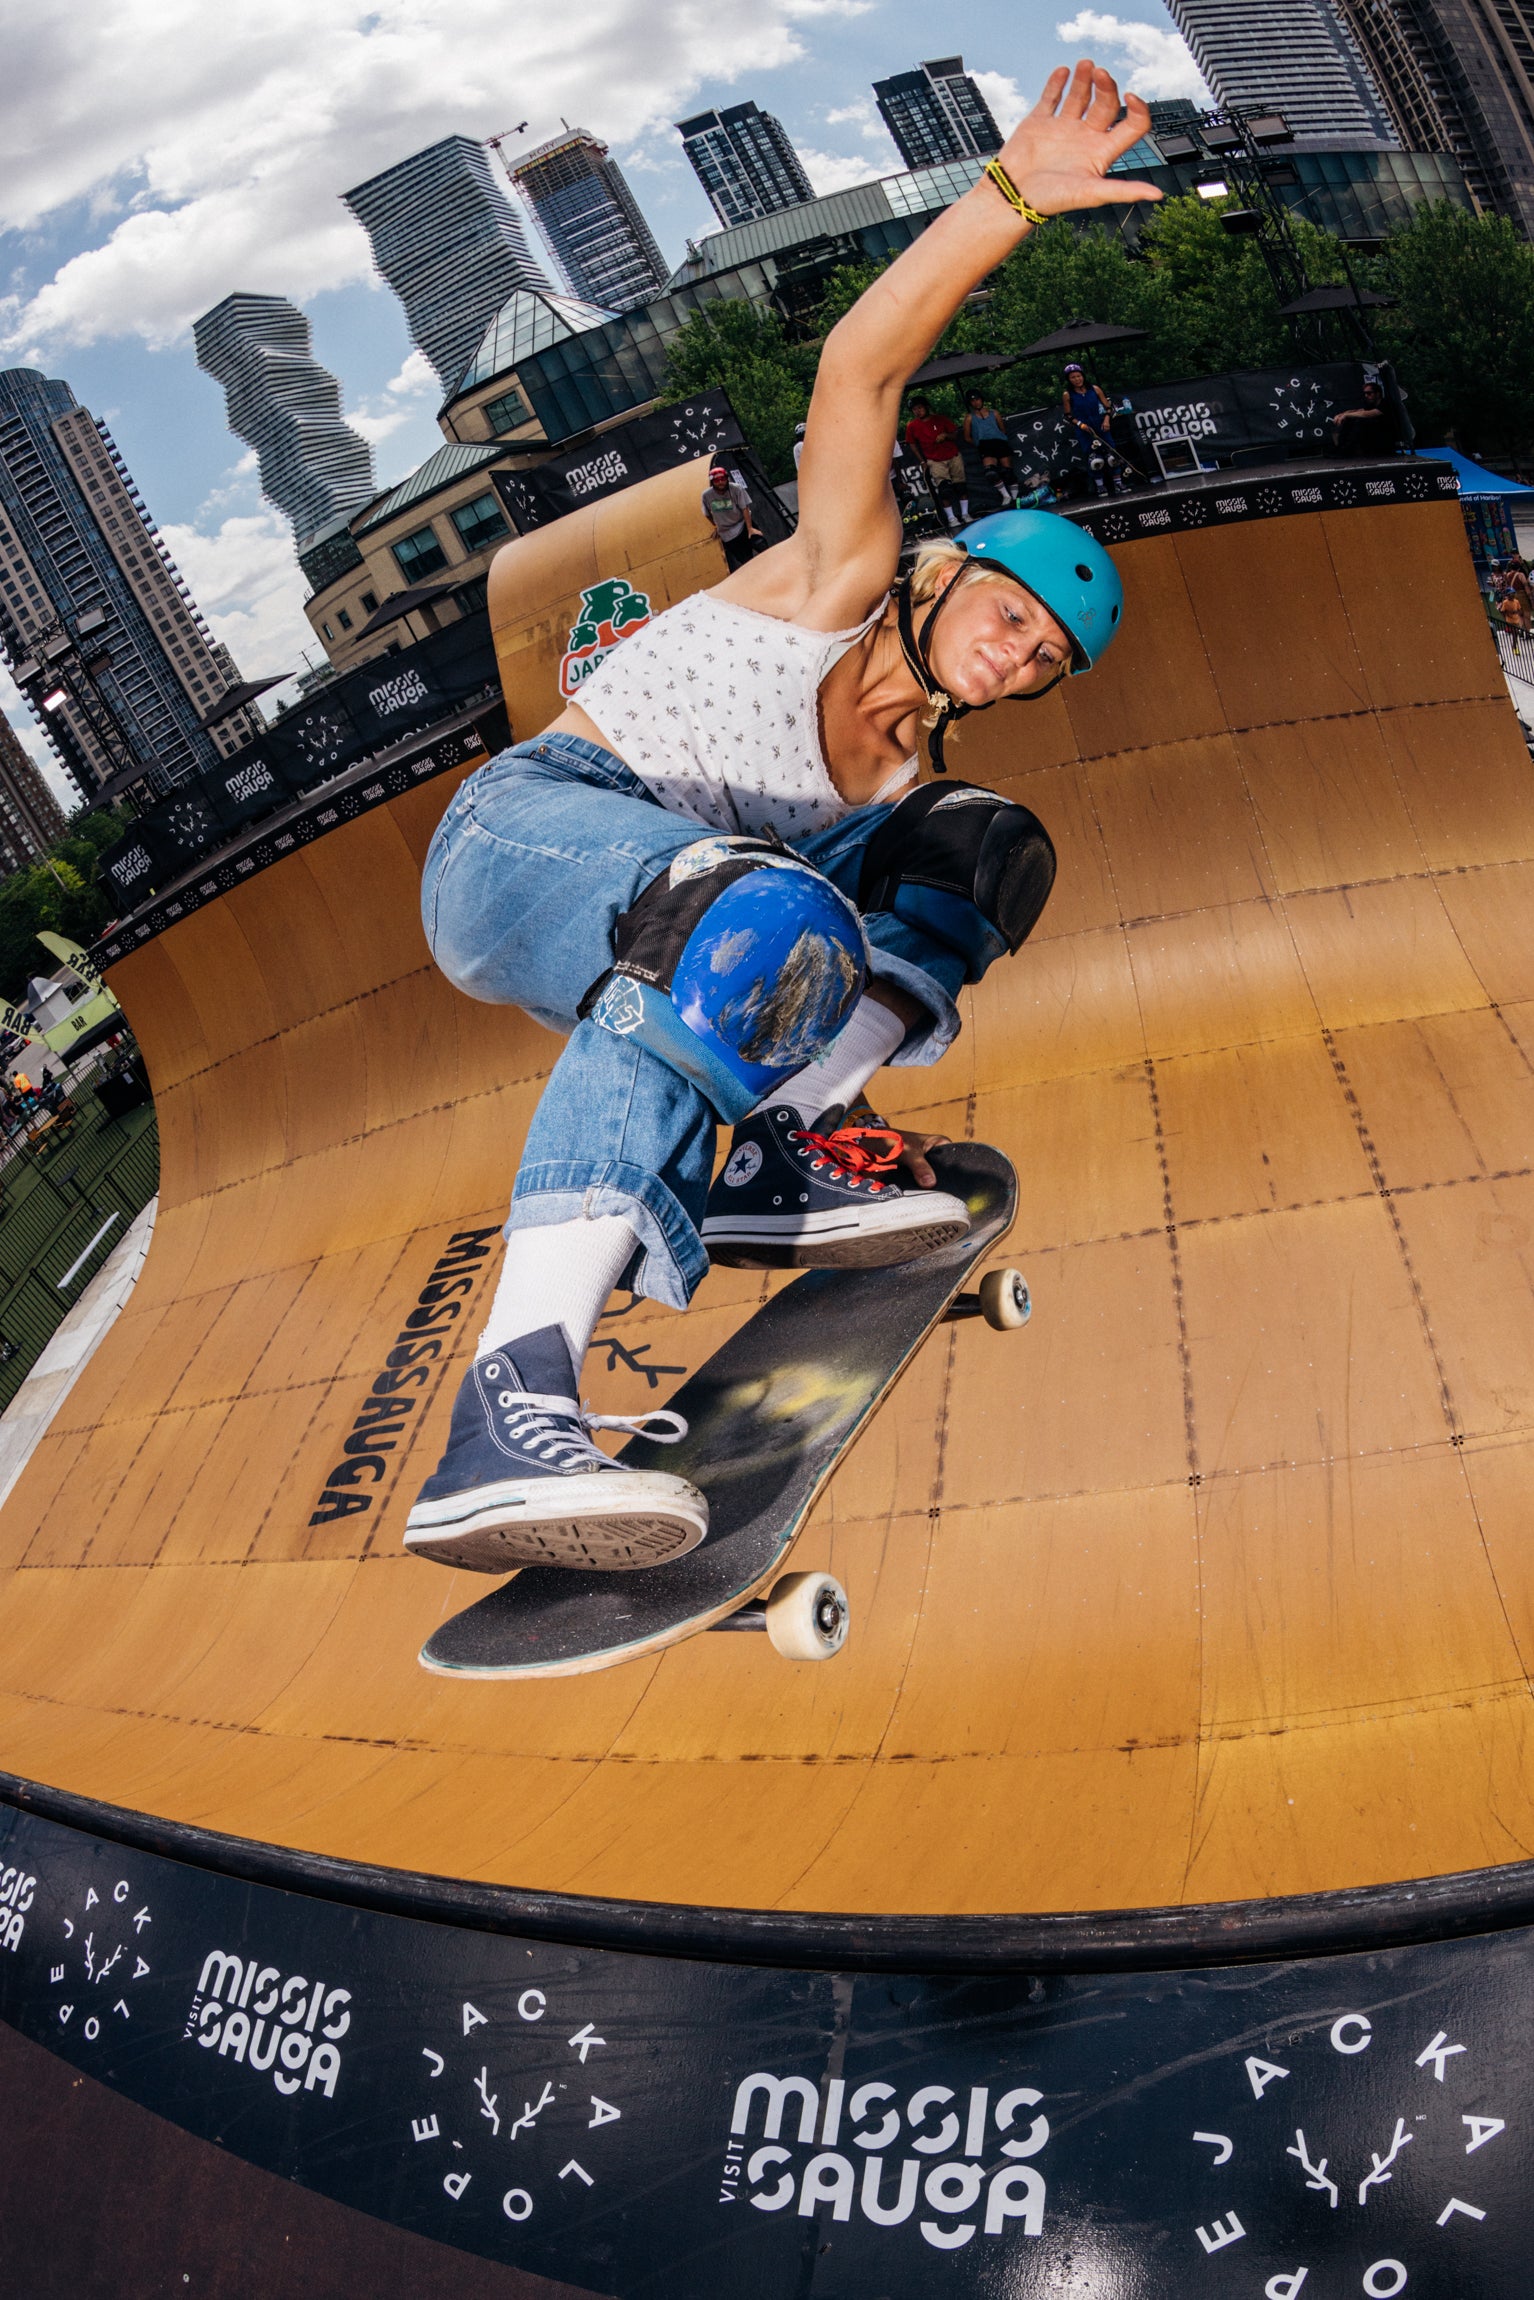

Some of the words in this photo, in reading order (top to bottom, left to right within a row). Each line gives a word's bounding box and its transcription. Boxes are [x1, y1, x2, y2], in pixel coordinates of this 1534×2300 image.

[71, 1016, 88, 1032] BAR
[307, 1224, 503, 1527] MISSISSAUGA
[183, 1995, 203, 2039] VISIT
[719, 2140, 745, 2203] VISIT
